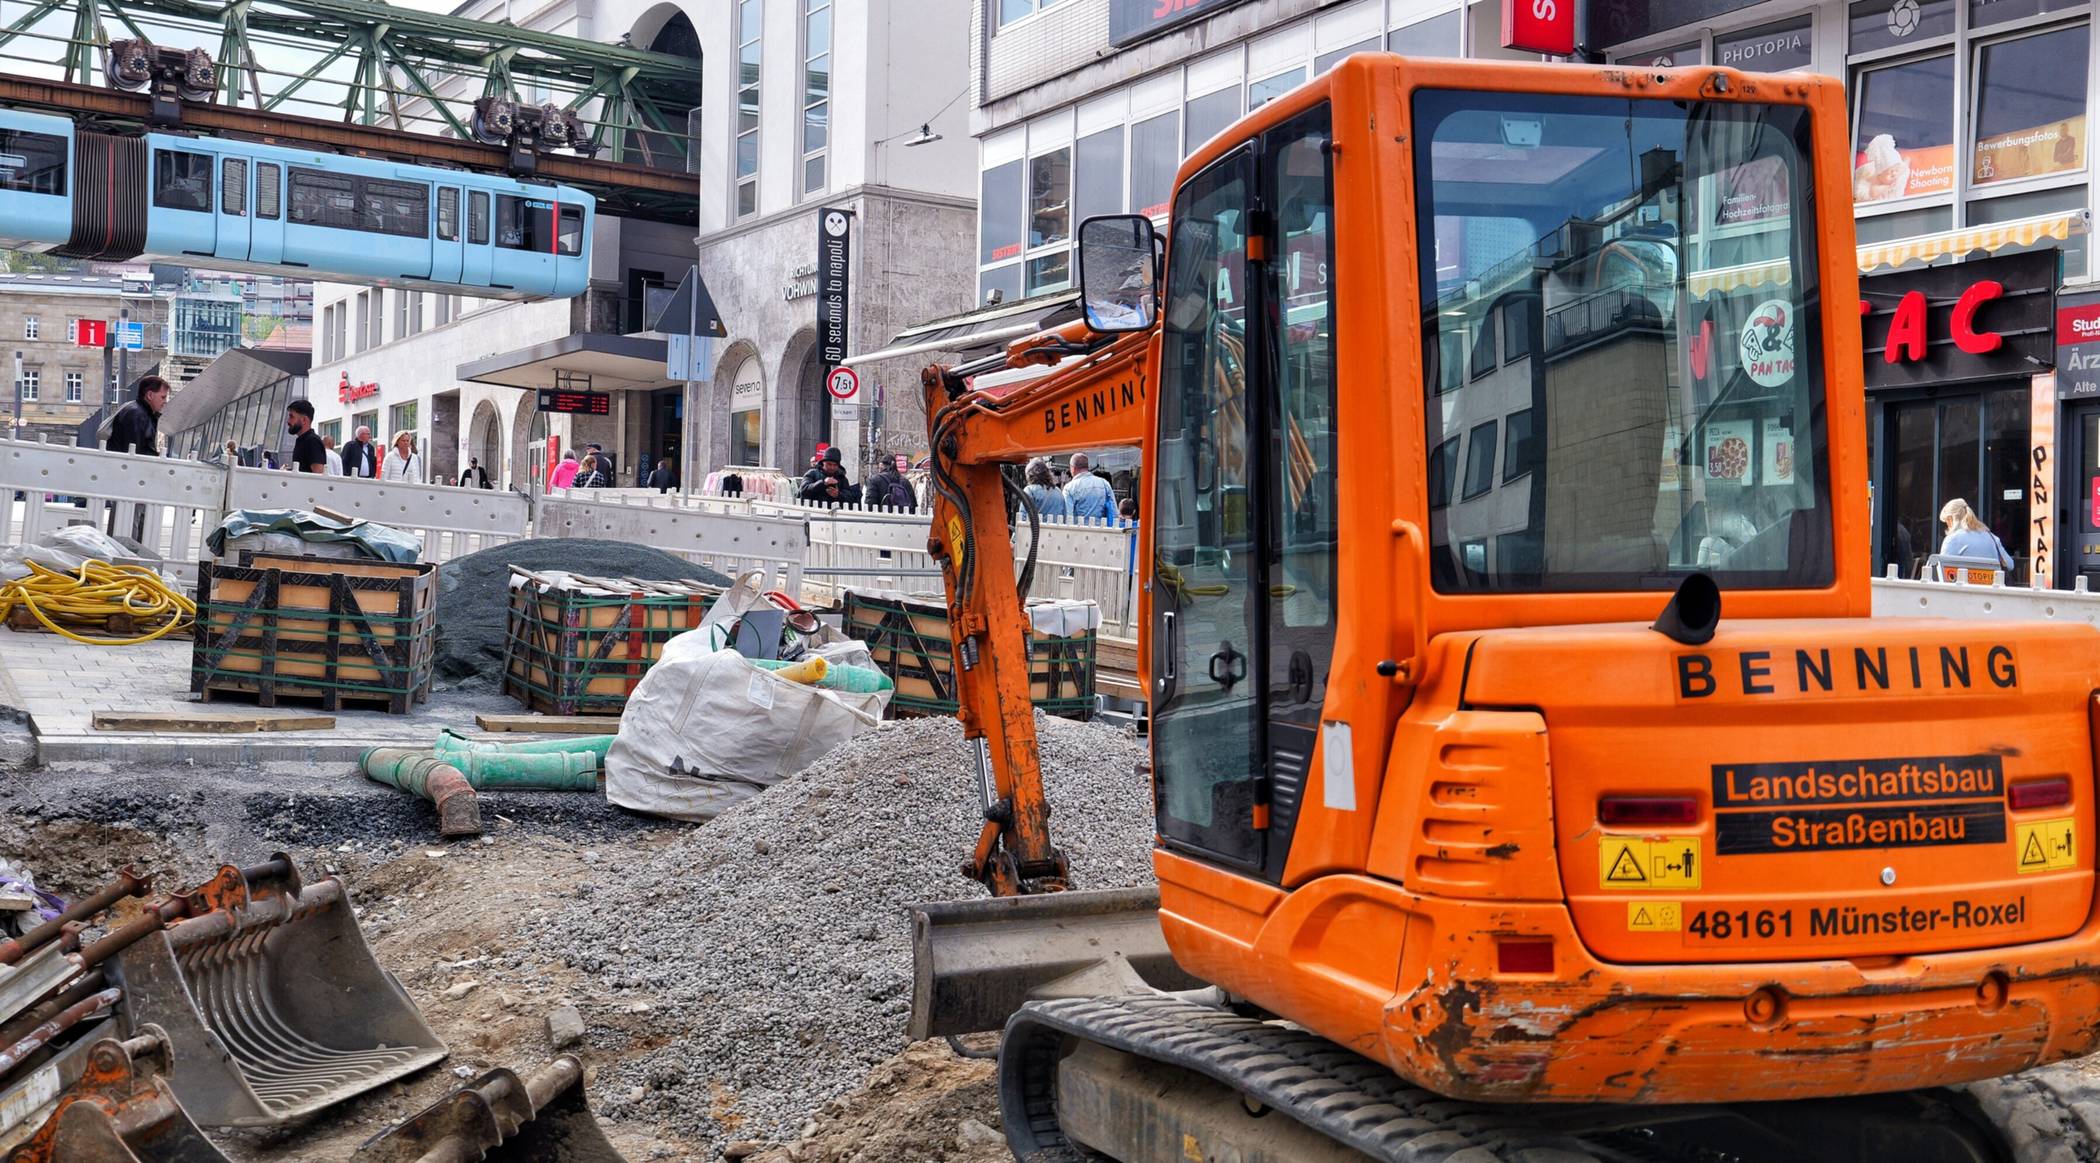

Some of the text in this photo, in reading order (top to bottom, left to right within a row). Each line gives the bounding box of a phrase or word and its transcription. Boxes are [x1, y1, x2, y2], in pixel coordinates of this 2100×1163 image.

[1723, 34, 1802, 65] PHOTOPIA
[1977, 130, 2059, 152] Bewerbungsfotos
[1910, 164, 1953, 178] Newborn
[1910, 176, 1950, 189] Shooting
[1722, 193, 1757, 205] Familien-
[825, 240, 846, 362] 60 seconds to napoli
[1860, 280, 2004, 364] AC
[2072, 317, 2100, 332] Stud
[1750, 362, 1775, 377] PAN
[2073, 381, 2097, 393] Alte
[2032, 445, 2048, 505] PAN
[2033, 516, 2048, 574] TAC
[1677, 645, 2018, 699] BENNING
[1725, 763, 1995, 802] Landschaftsbau
[1771, 812, 1966, 847] Straßenbau
[1688, 896, 2026, 939] 48161 Münster-Roxel
